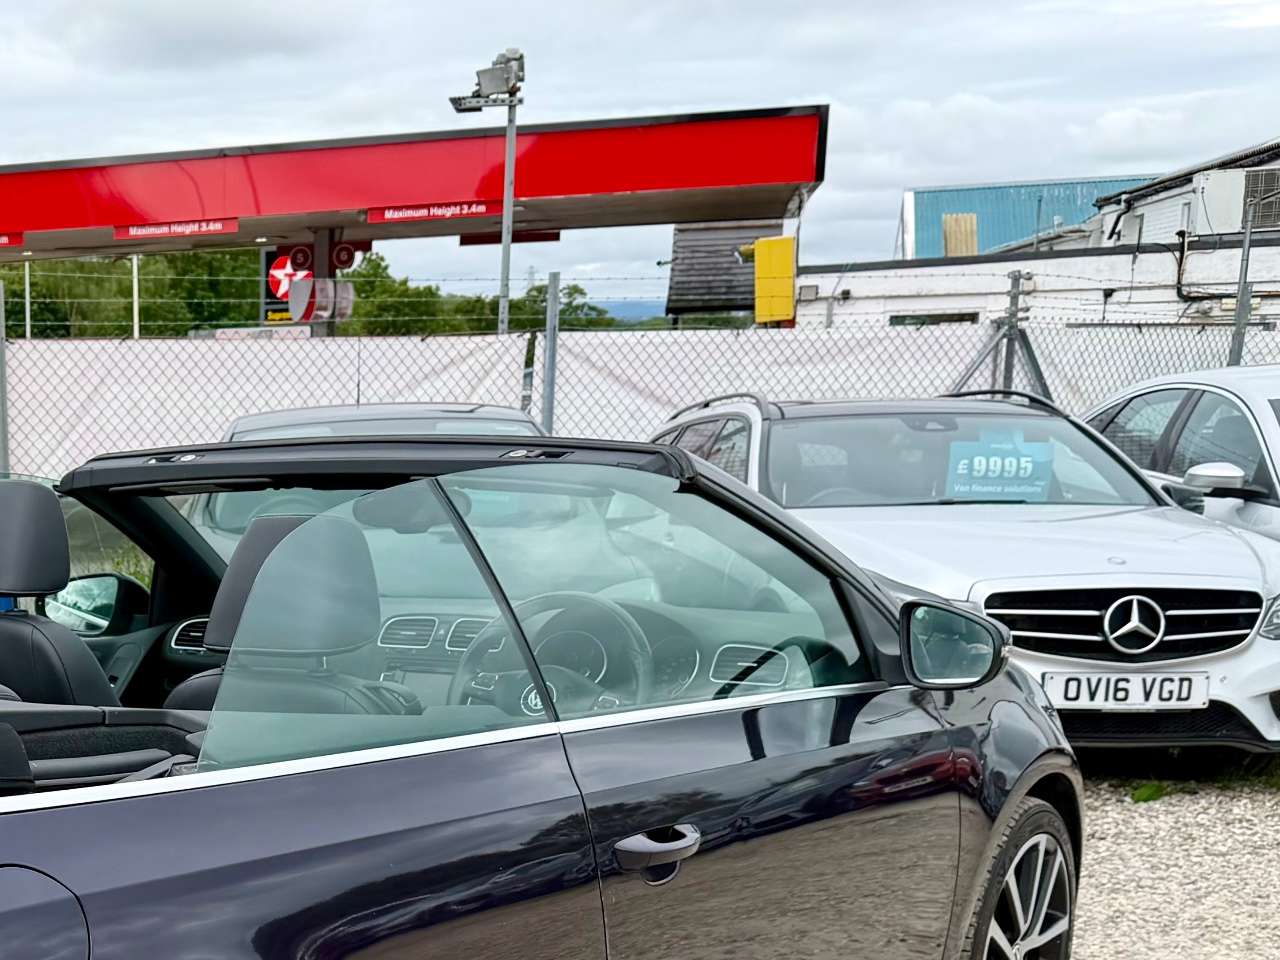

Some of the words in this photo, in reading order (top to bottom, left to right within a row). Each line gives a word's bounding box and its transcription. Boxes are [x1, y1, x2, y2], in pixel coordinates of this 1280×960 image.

[384, 208, 428, 219] Maximum
[429, 205, 460, 217] Height
[461, 204, 486, 214] 3.4m
[128, 226, 169, 235] Maximum
[170, 223, 198, 234] Height
[200, 222, 222, 231] 3.4m
[971, 484, 1002, 493] finance
[1004, 484, 1042, 493] solutions
[1063, 677, 1132, 702] OV16
[1141, 677, 1192, 702] VGD
